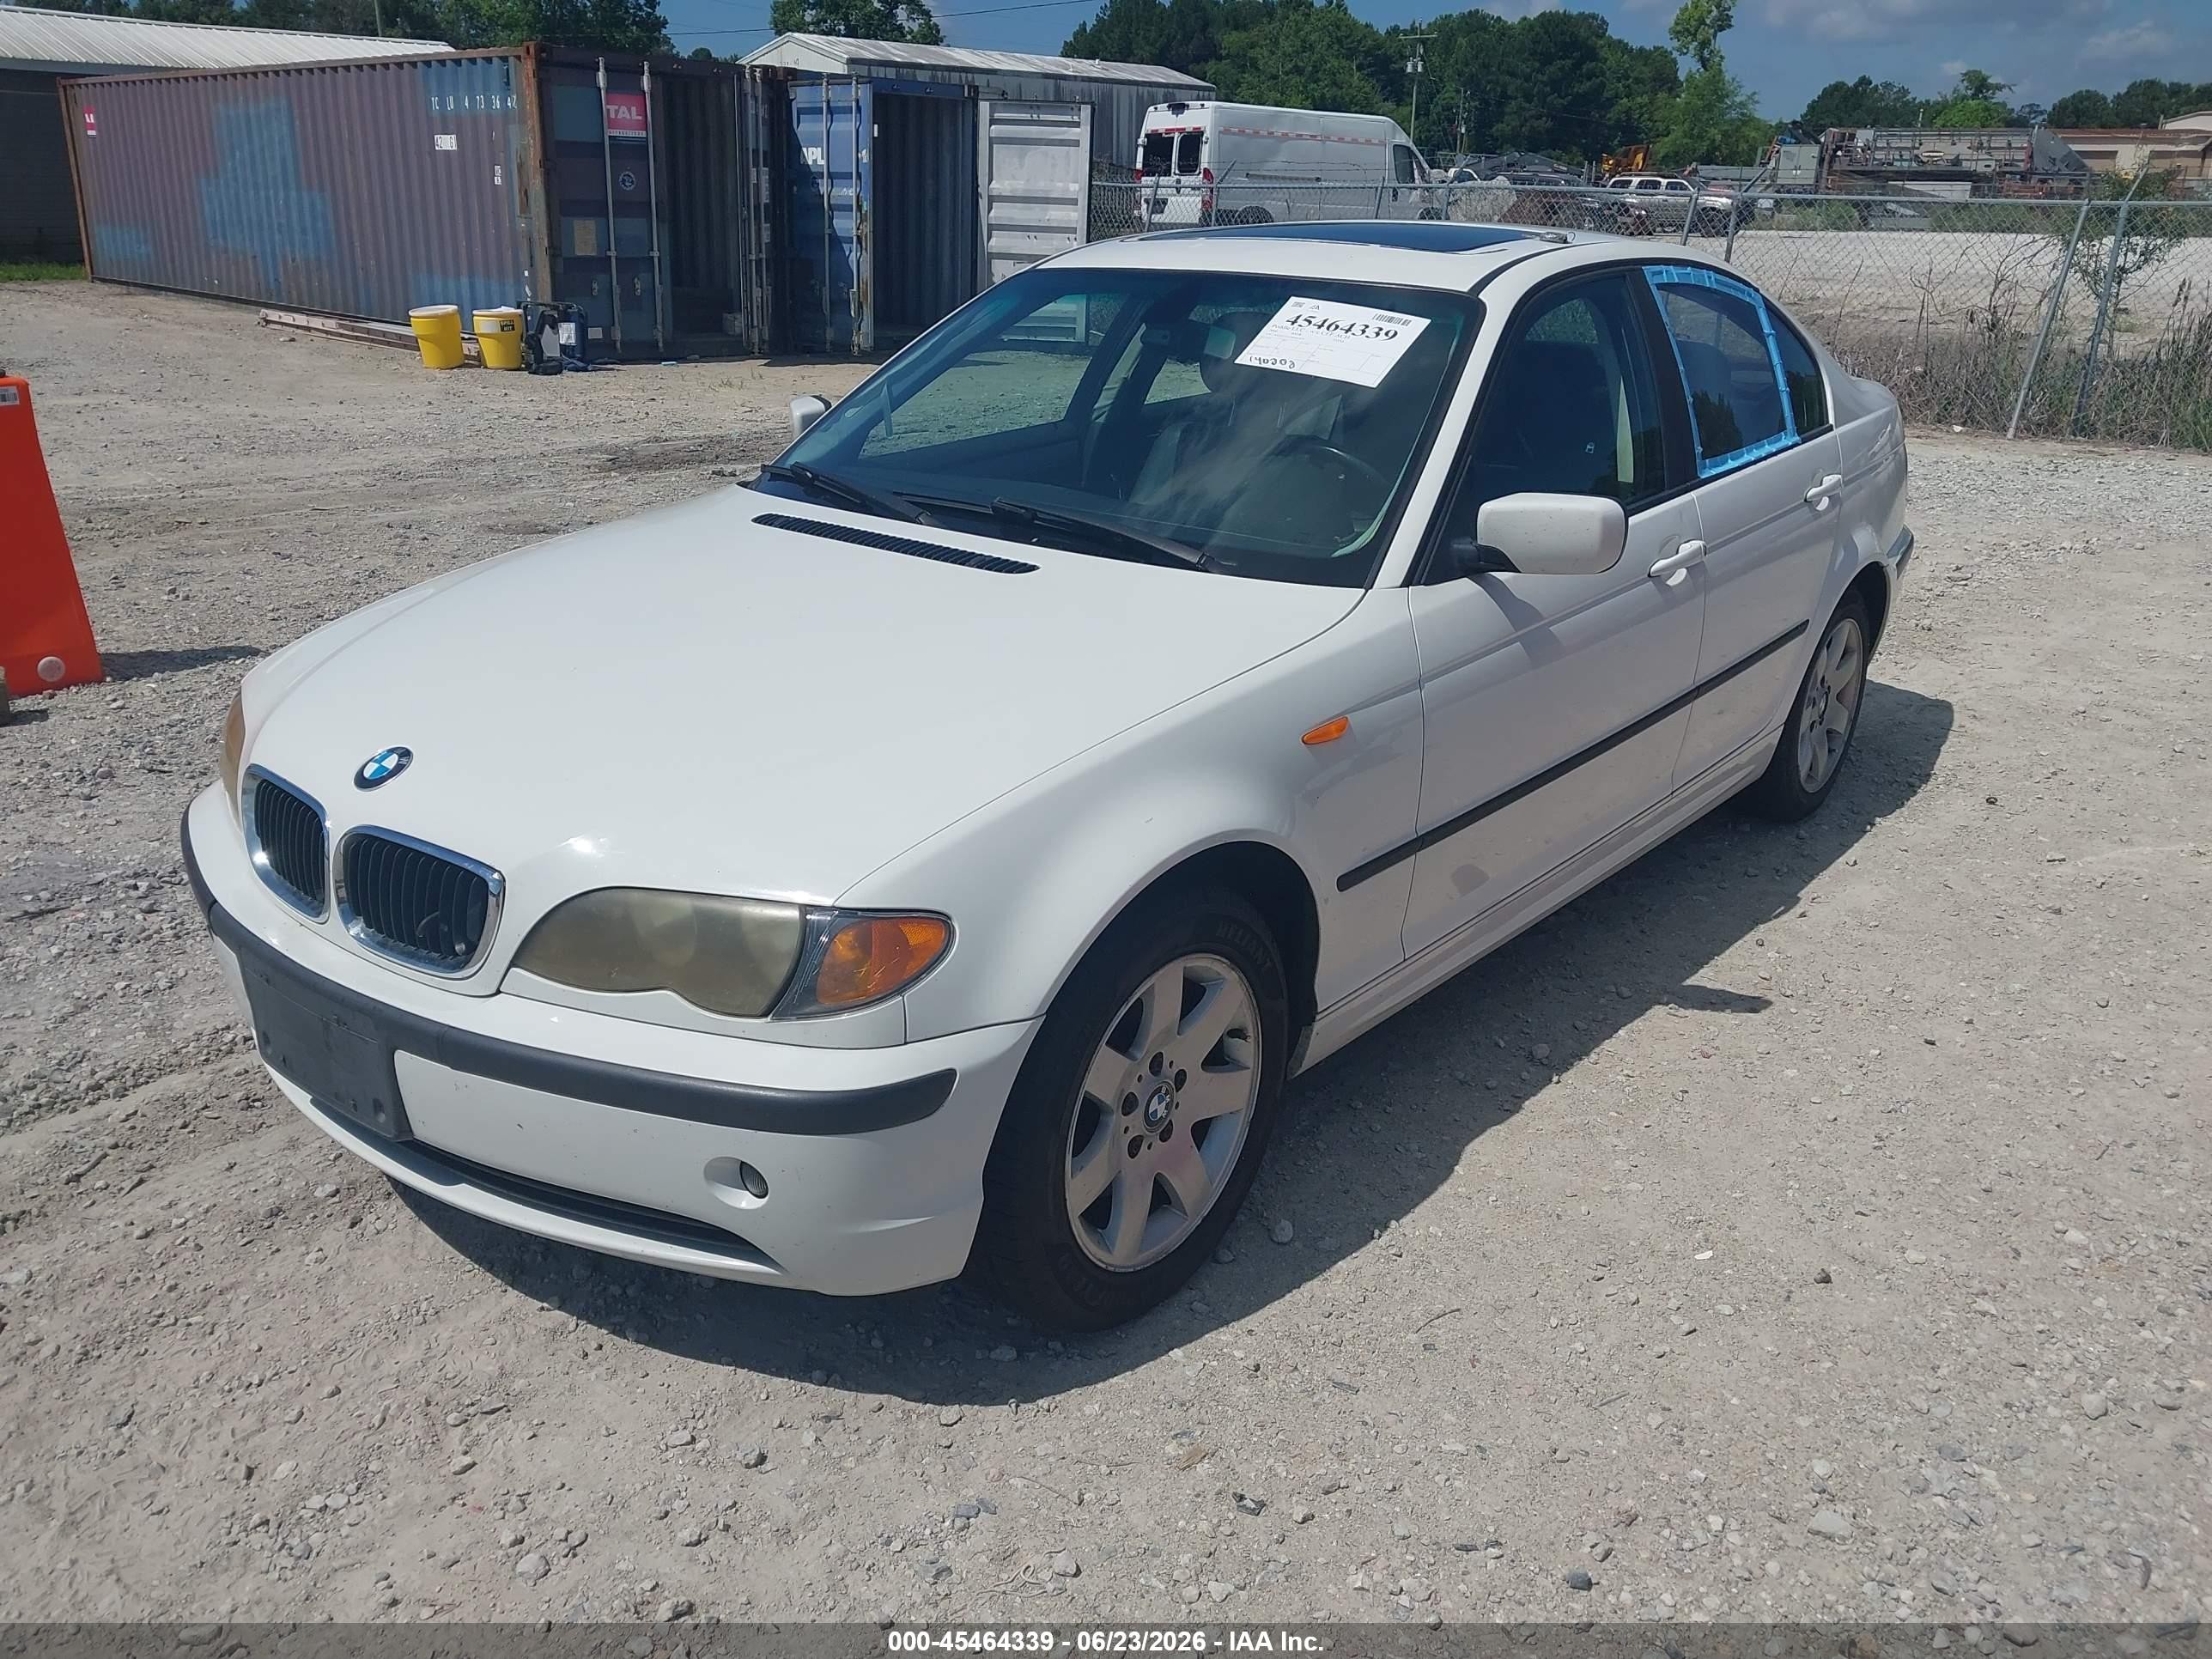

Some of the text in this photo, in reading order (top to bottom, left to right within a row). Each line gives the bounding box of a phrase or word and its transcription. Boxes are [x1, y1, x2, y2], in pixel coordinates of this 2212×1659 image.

[606, 105, 642, 119] TAL
[799, 147, 825, 165] APL
[1285, 313, 1399, 342] 45464339
